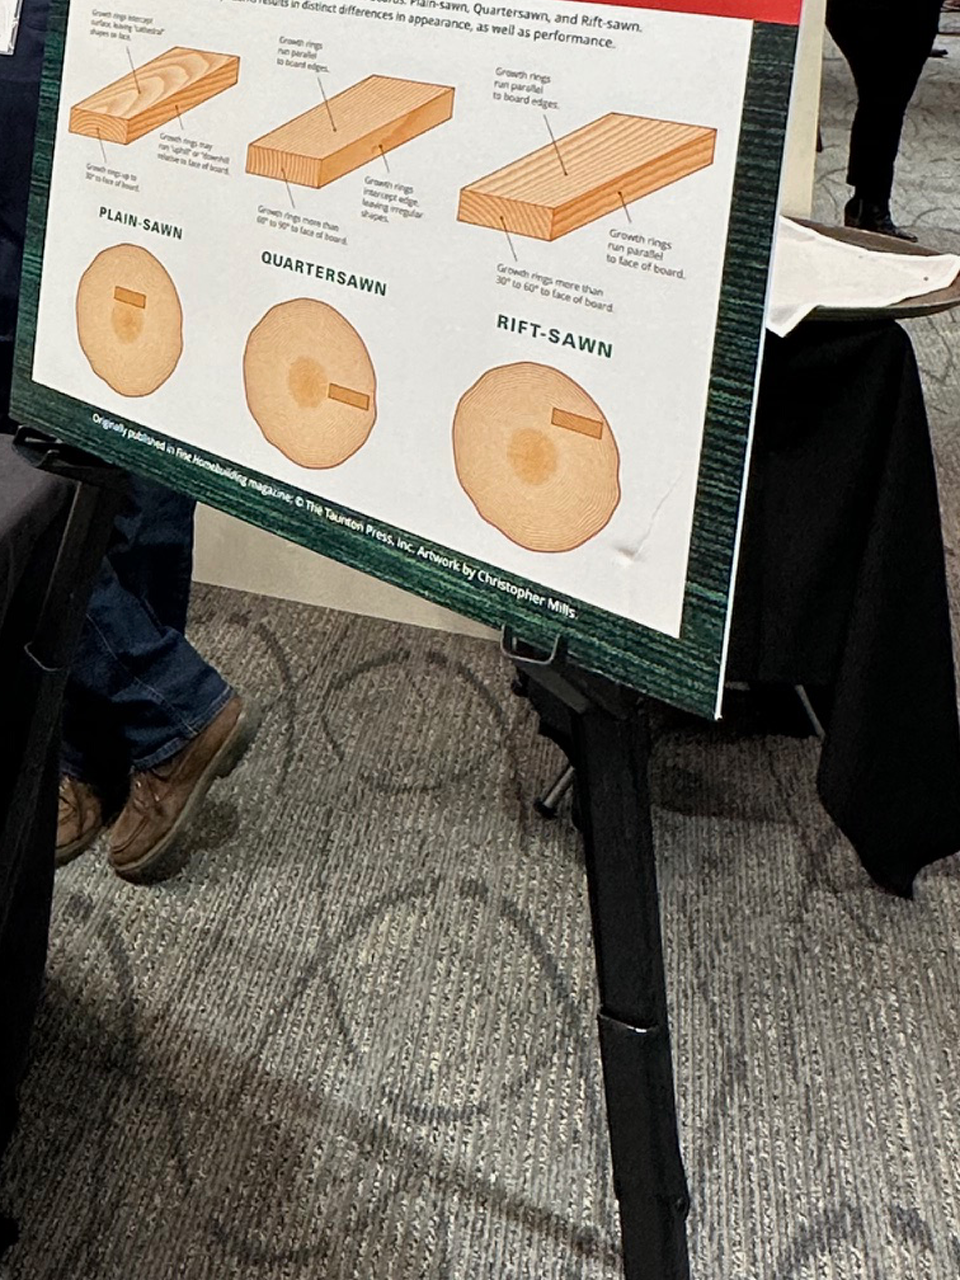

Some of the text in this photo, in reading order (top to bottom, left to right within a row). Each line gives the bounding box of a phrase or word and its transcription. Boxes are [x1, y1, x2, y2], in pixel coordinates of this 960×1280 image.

[300, 0, 337, 13] distinct
[338, 3, 394, 21] differences
[395, 11, 406, 22] in
[407, 14, 473, 33] appearance,
[475, 22, 489, 33] as
[491, 24, 515, 36] well
[516, 27, 531, 38] as
[532, 29, 616, 49] performance.
[472, 2, 551, 24] Quartersawn,
[553, 13, 578, 25] and
[580, 14, 642, 33] Rift-sawn.
[98, 205, 182, 240] PLAIN-SAWN
[608, 228, 672, 252] Growth rings
[605, 253, 617, 264] to
[618, 255, 639, 269] face
[640, 261, 652, 272] of
[607, 241, 665, 261] run parallel
[260, 250, 387, 297] QUARTERSAWN
[496, 313, 613, 359] RIFT-SAWN
[305, 499, 323, 516] The
[324, 506, 364, 532] Taunton
[416, 545, 460, 572] Artwork
[461, 562, 476, 580] by
[477, 569, 546, 605] Christopher
